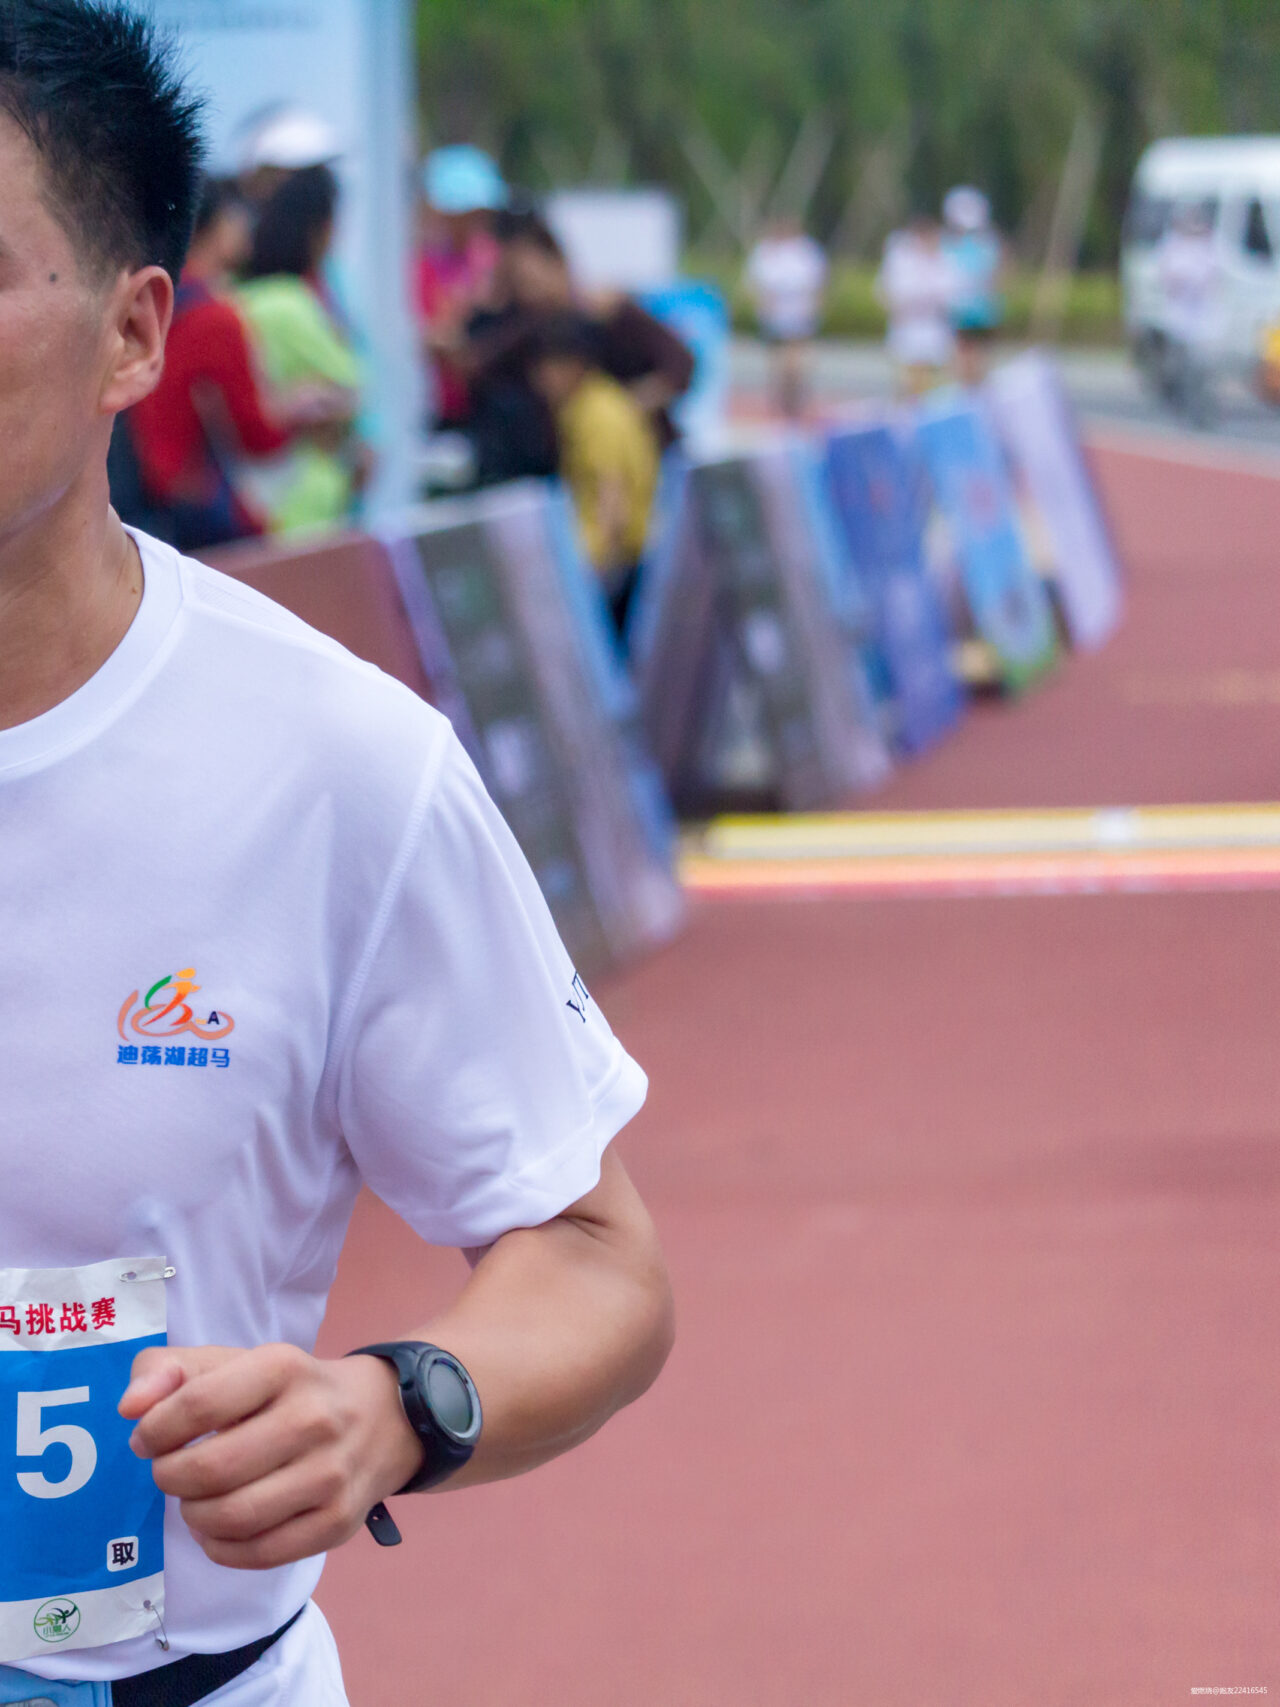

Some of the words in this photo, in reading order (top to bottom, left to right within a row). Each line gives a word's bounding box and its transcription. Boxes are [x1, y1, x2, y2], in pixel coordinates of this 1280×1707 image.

[117, 1045, 230, 1068] 迪荡湖超马
[112, 1540, 135, 1567] 取
